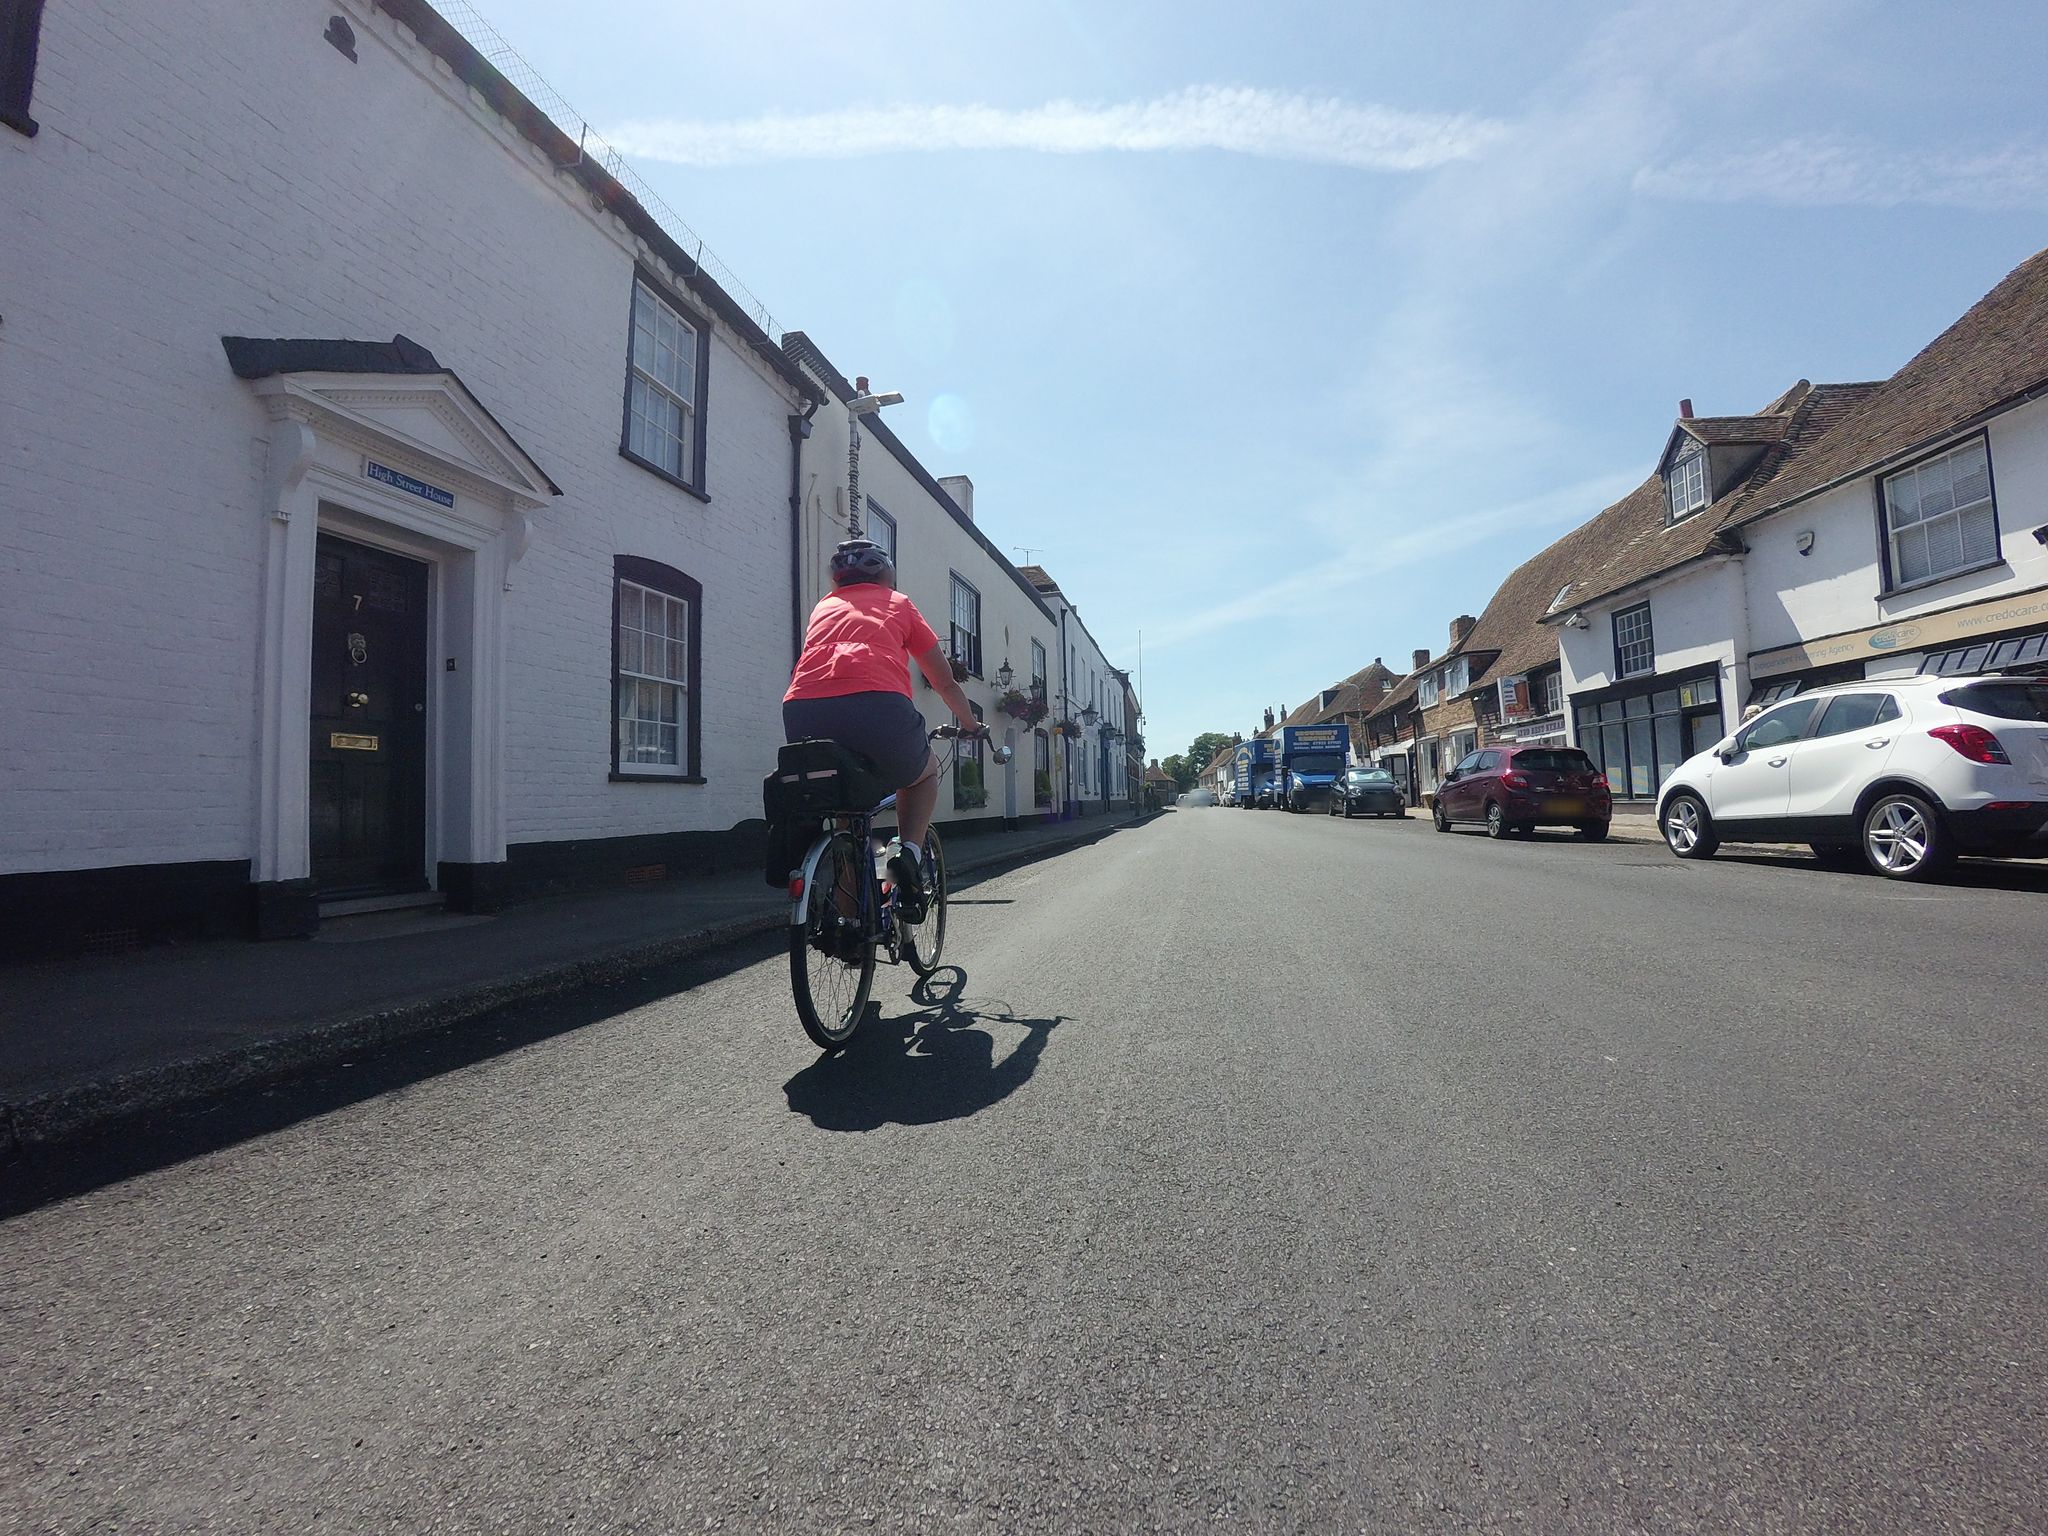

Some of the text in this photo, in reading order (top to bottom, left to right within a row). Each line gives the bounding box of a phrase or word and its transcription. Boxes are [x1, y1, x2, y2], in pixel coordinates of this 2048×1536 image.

[369, 463, 453, 506] High Street House
[353, 594, 362, 611] 7
